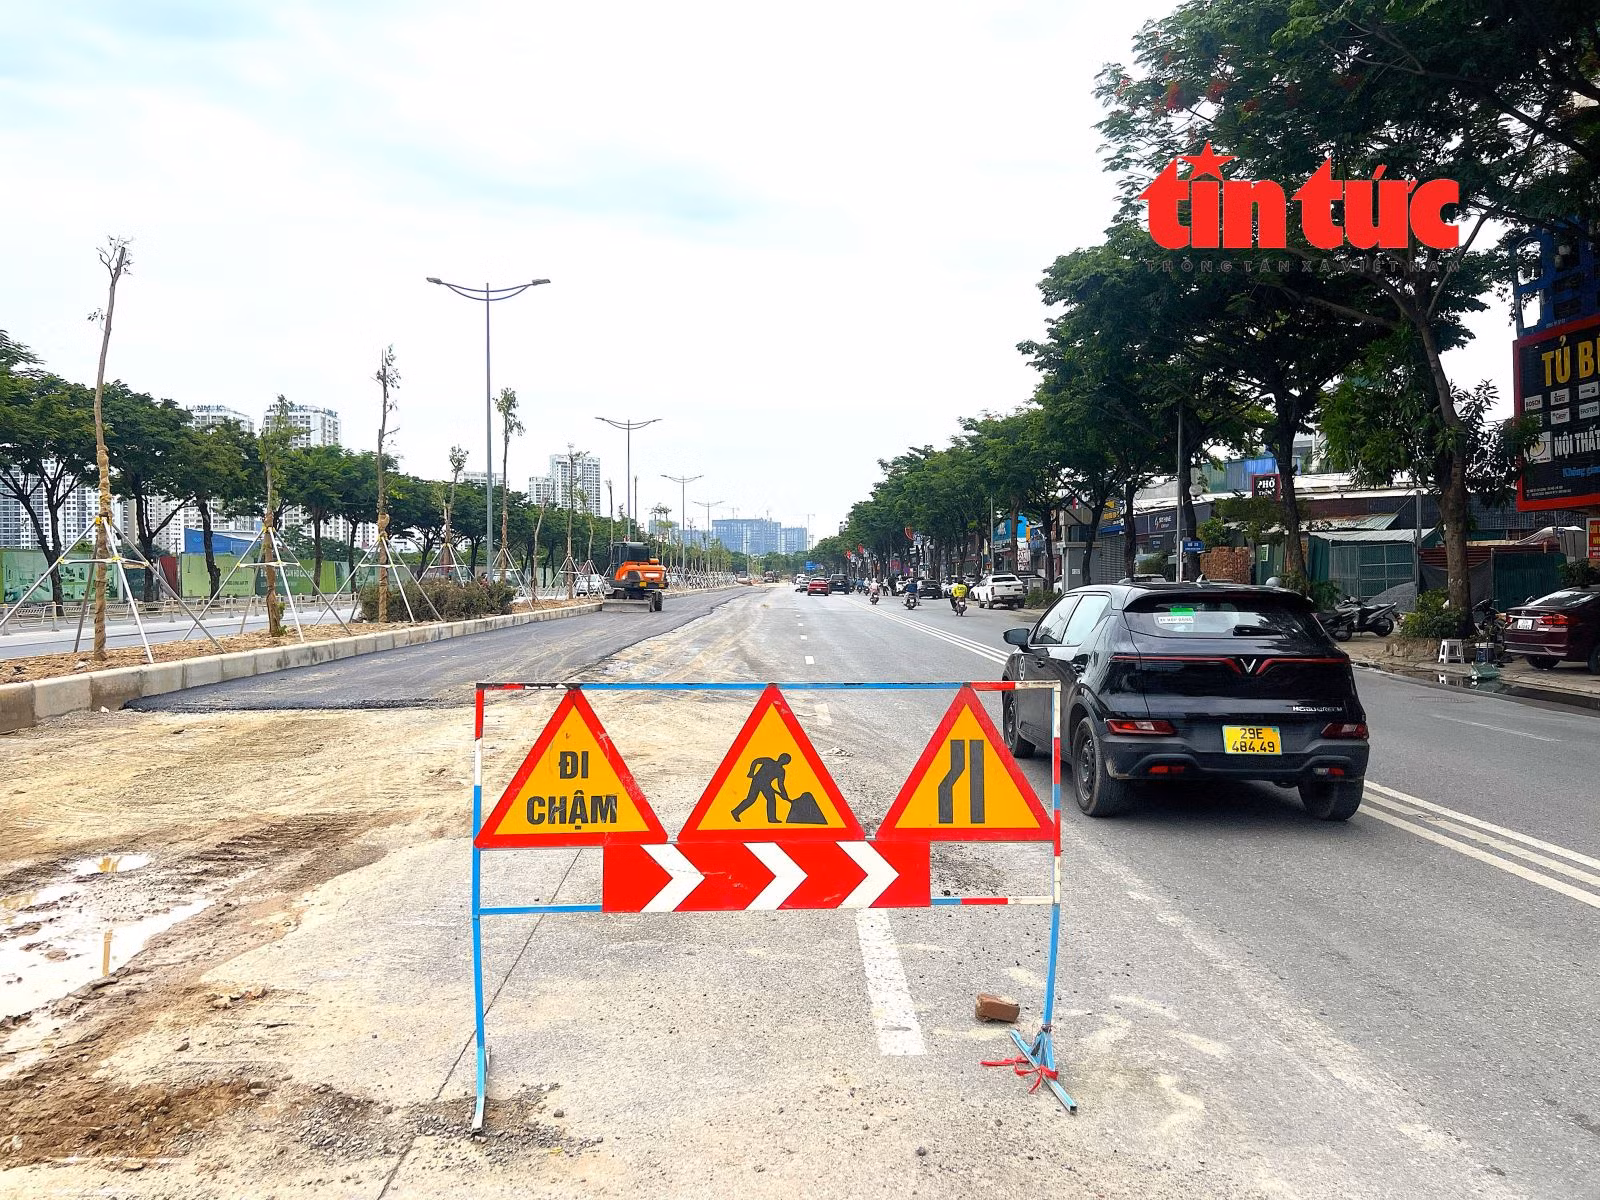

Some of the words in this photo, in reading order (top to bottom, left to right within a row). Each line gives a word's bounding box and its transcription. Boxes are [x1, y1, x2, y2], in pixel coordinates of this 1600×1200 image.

[1541, 335, 1571, 387] TỦ
[1554, 431, 1574, 459] NỘI
[1232, 740, 1275, 753] 484.49
[1240, 728, 1264, 739] 29E
[558, 751, 589, 779] ĐI
[526, 789, 618, 830] CHẬM
